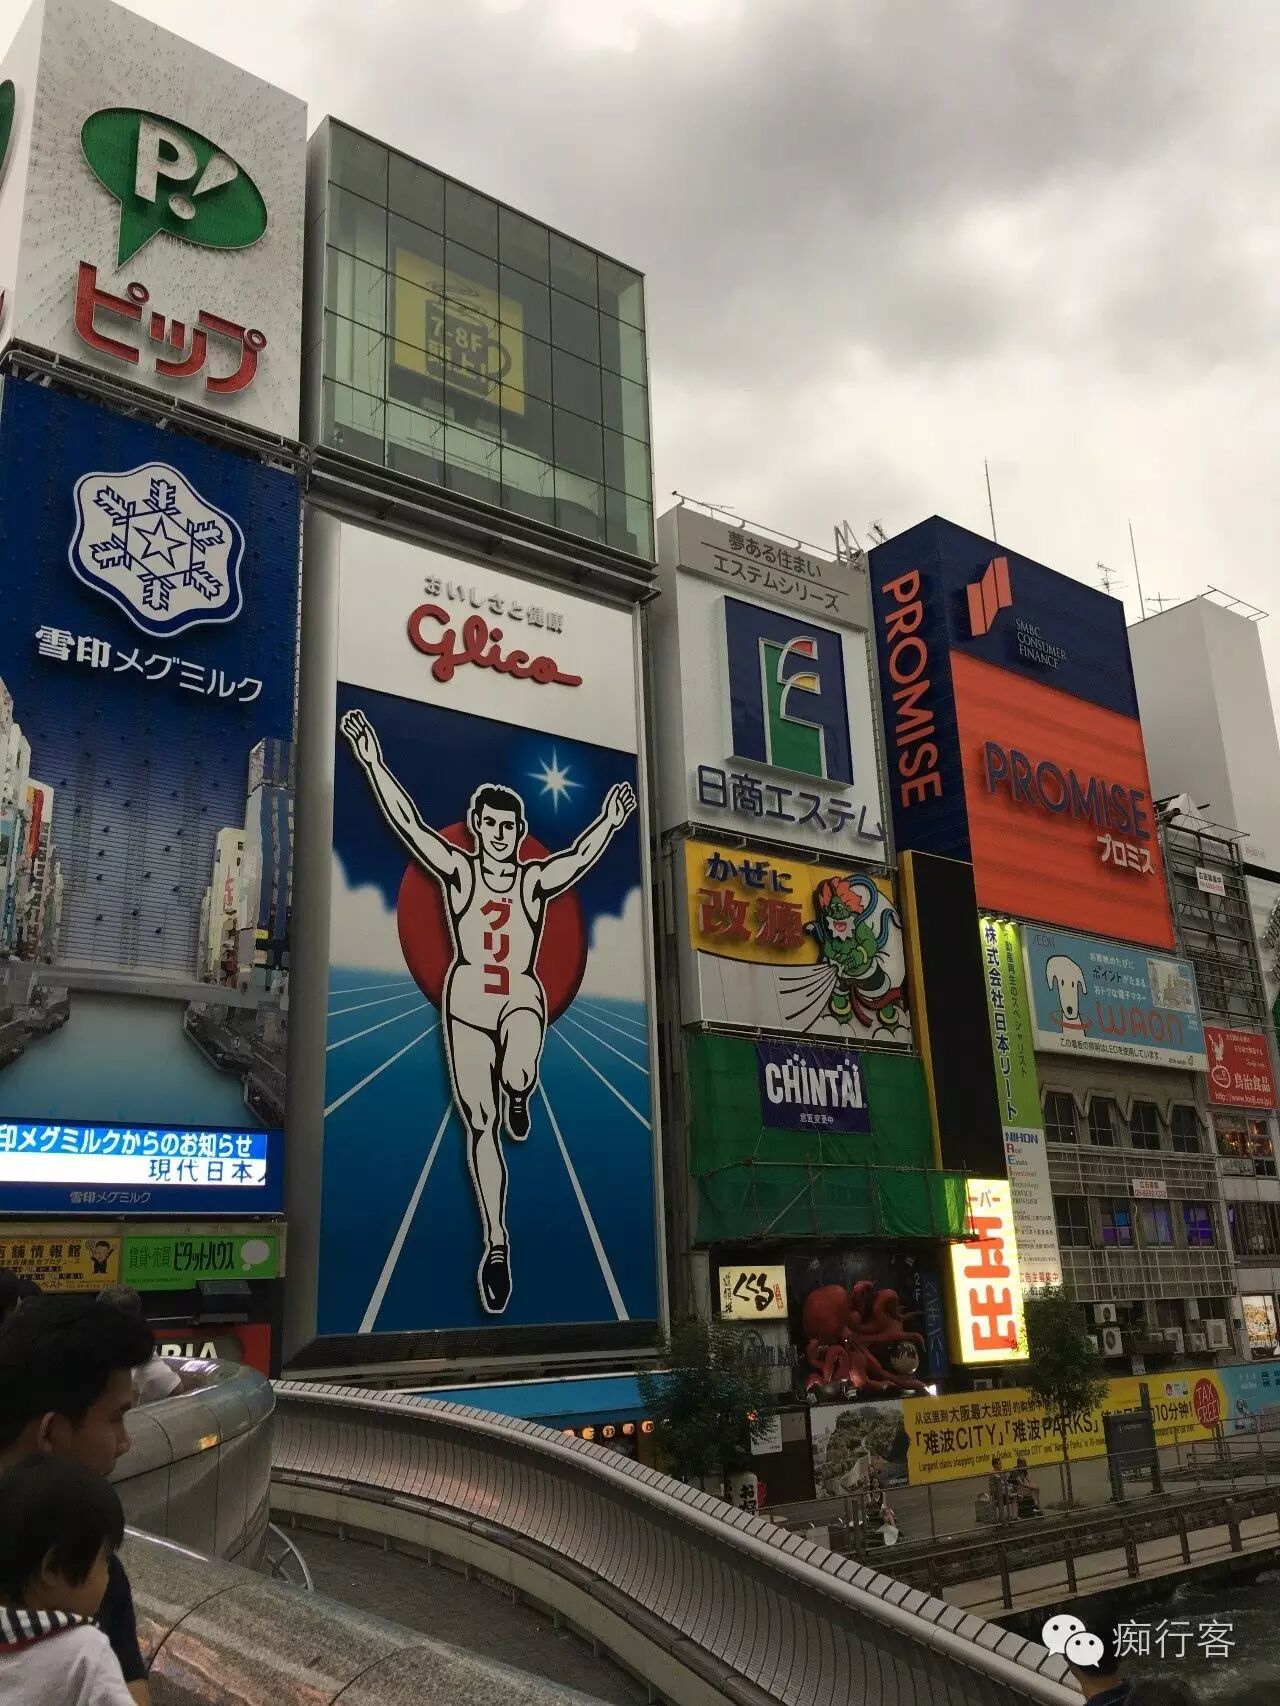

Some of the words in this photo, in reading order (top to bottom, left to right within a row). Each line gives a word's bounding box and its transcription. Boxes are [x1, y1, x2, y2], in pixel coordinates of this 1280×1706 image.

[74, 261, 267, 394] ピップ
[728, 531, 821, 578] 夢ある住まい
[424, 576, 563, 634] おいしさと健康
[713, 554, 839, 613] エステムシリーズ
[407, 603, 583, 687] Glico
[1015, 618, 1042, 639] SMBC
[1016, 631, 1068, 662] CONSUMER
[34, 625, 262, 702] 雪印メグミルク
[1018, 643, 1060, 670] FINANCE
[881, 568, 942, 808] PROMISE
[698, 765, 887, 843] 日商エステム
[984, 740, 1151, 841] PROMISE
[706, 852, 794, 894] かぜに
[1096, 834, 1156, 875] プロミス
[697, 887, 806, 949] 改源
[480, 897, 514, 996] グリコ
[984, 925, 1017, 1122] 株式会社日本リート
[765, 1054, 863, 1109] CHINTAI
[1005, 1131, 1039, 1145] NIHON
[69, 1191, 151, 1205] 雪印メグミルク
[174, 1241, 235, 1272] ピタットハウス
[963, 1216, 1018, 1351] 玉出
[732, 1272, 774, 1312] くくる
[1195, 1383, 1216, 1402] TAX
[1197, 1399, 1219, 1426] FREE
